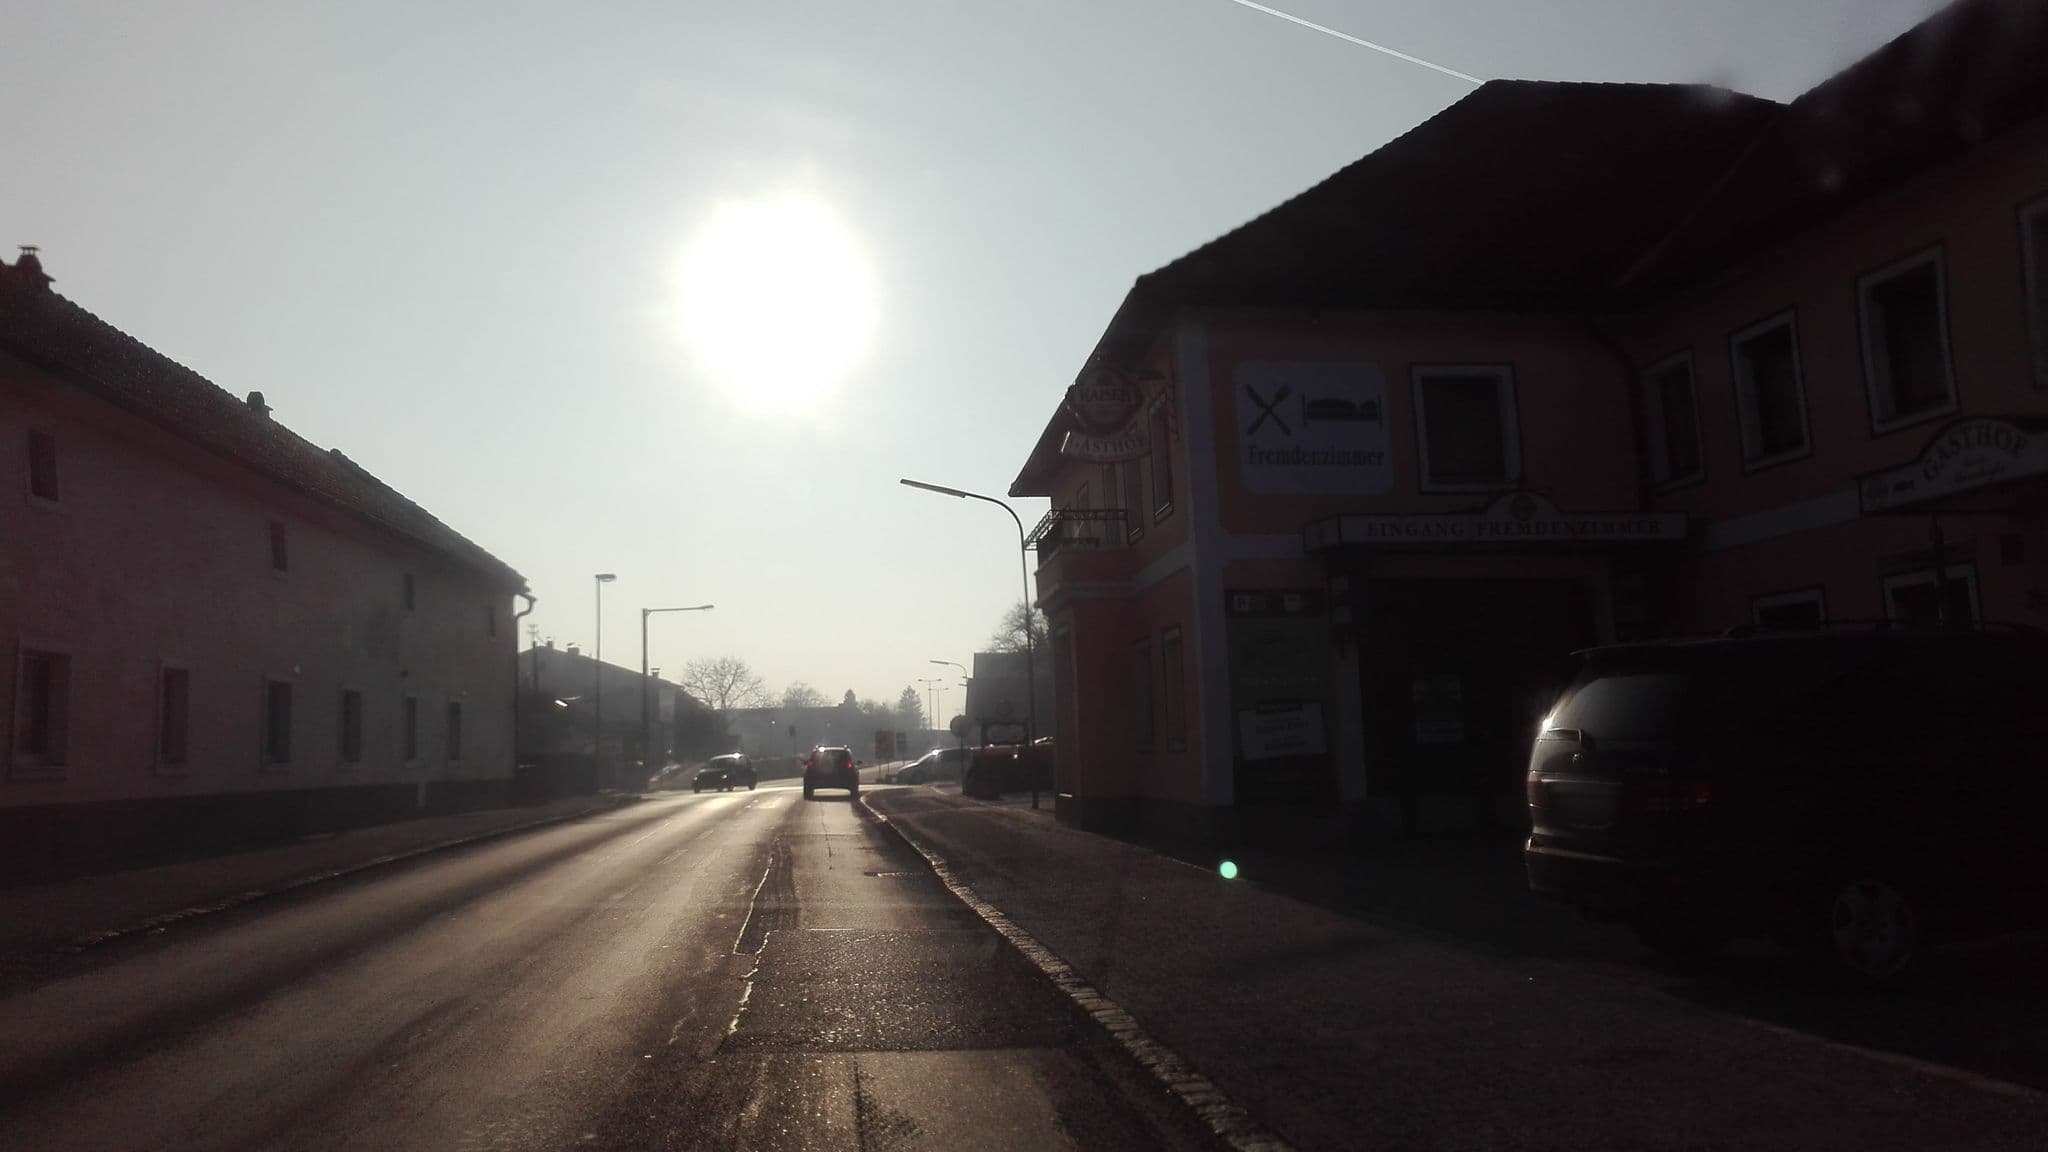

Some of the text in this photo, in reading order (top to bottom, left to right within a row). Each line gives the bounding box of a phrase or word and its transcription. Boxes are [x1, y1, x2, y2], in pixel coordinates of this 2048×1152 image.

[1080, 387, 1132, 402] KAISER
[1071, 437, 1145, 454] GASTHOF
[1247, 444, 1384, 466] Fremdenzimmer
[1922, 424, 2028, 481] GASTHOF
[1367, 518, 1664, 537] EINGANG FREMDENZIMMER
